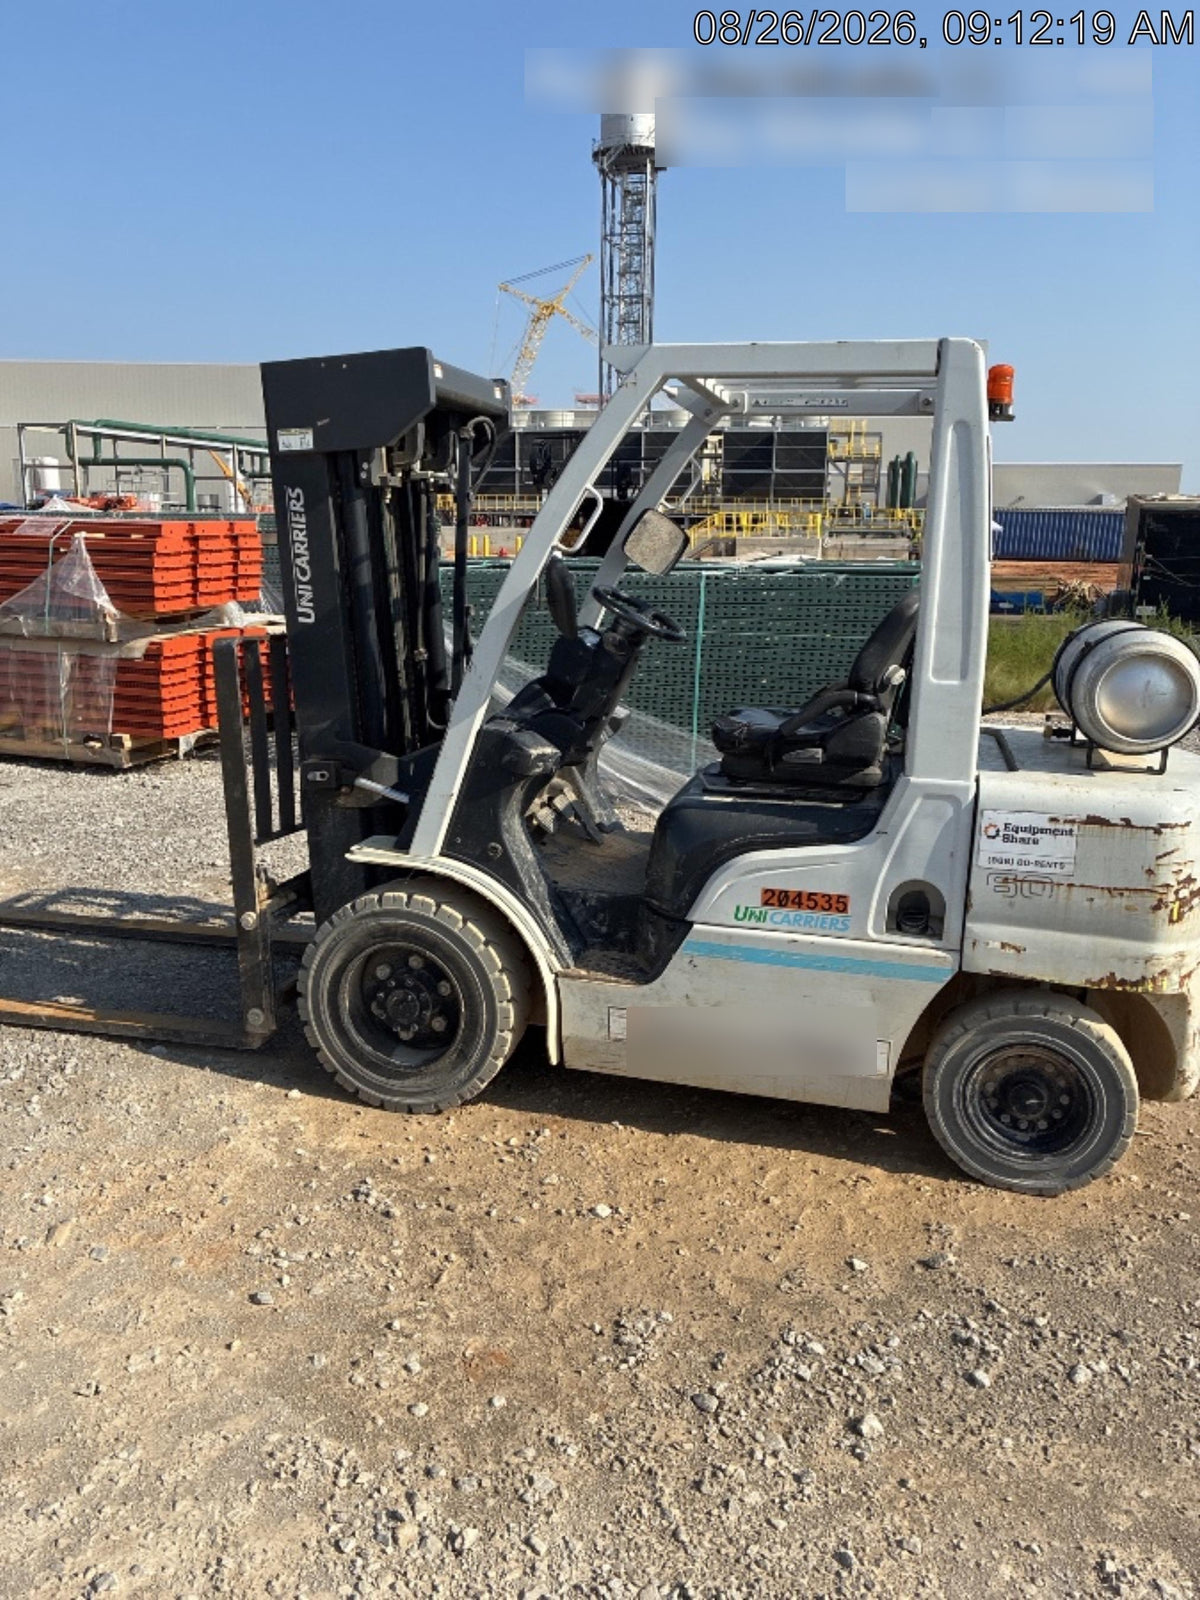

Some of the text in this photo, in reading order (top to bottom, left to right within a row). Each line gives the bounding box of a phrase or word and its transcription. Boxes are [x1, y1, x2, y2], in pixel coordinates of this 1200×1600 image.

[1003, 823, 1074, 836] Equipment
[1002, 833, 1040, 846] Share
[763, 888, 849, 913] 204535
